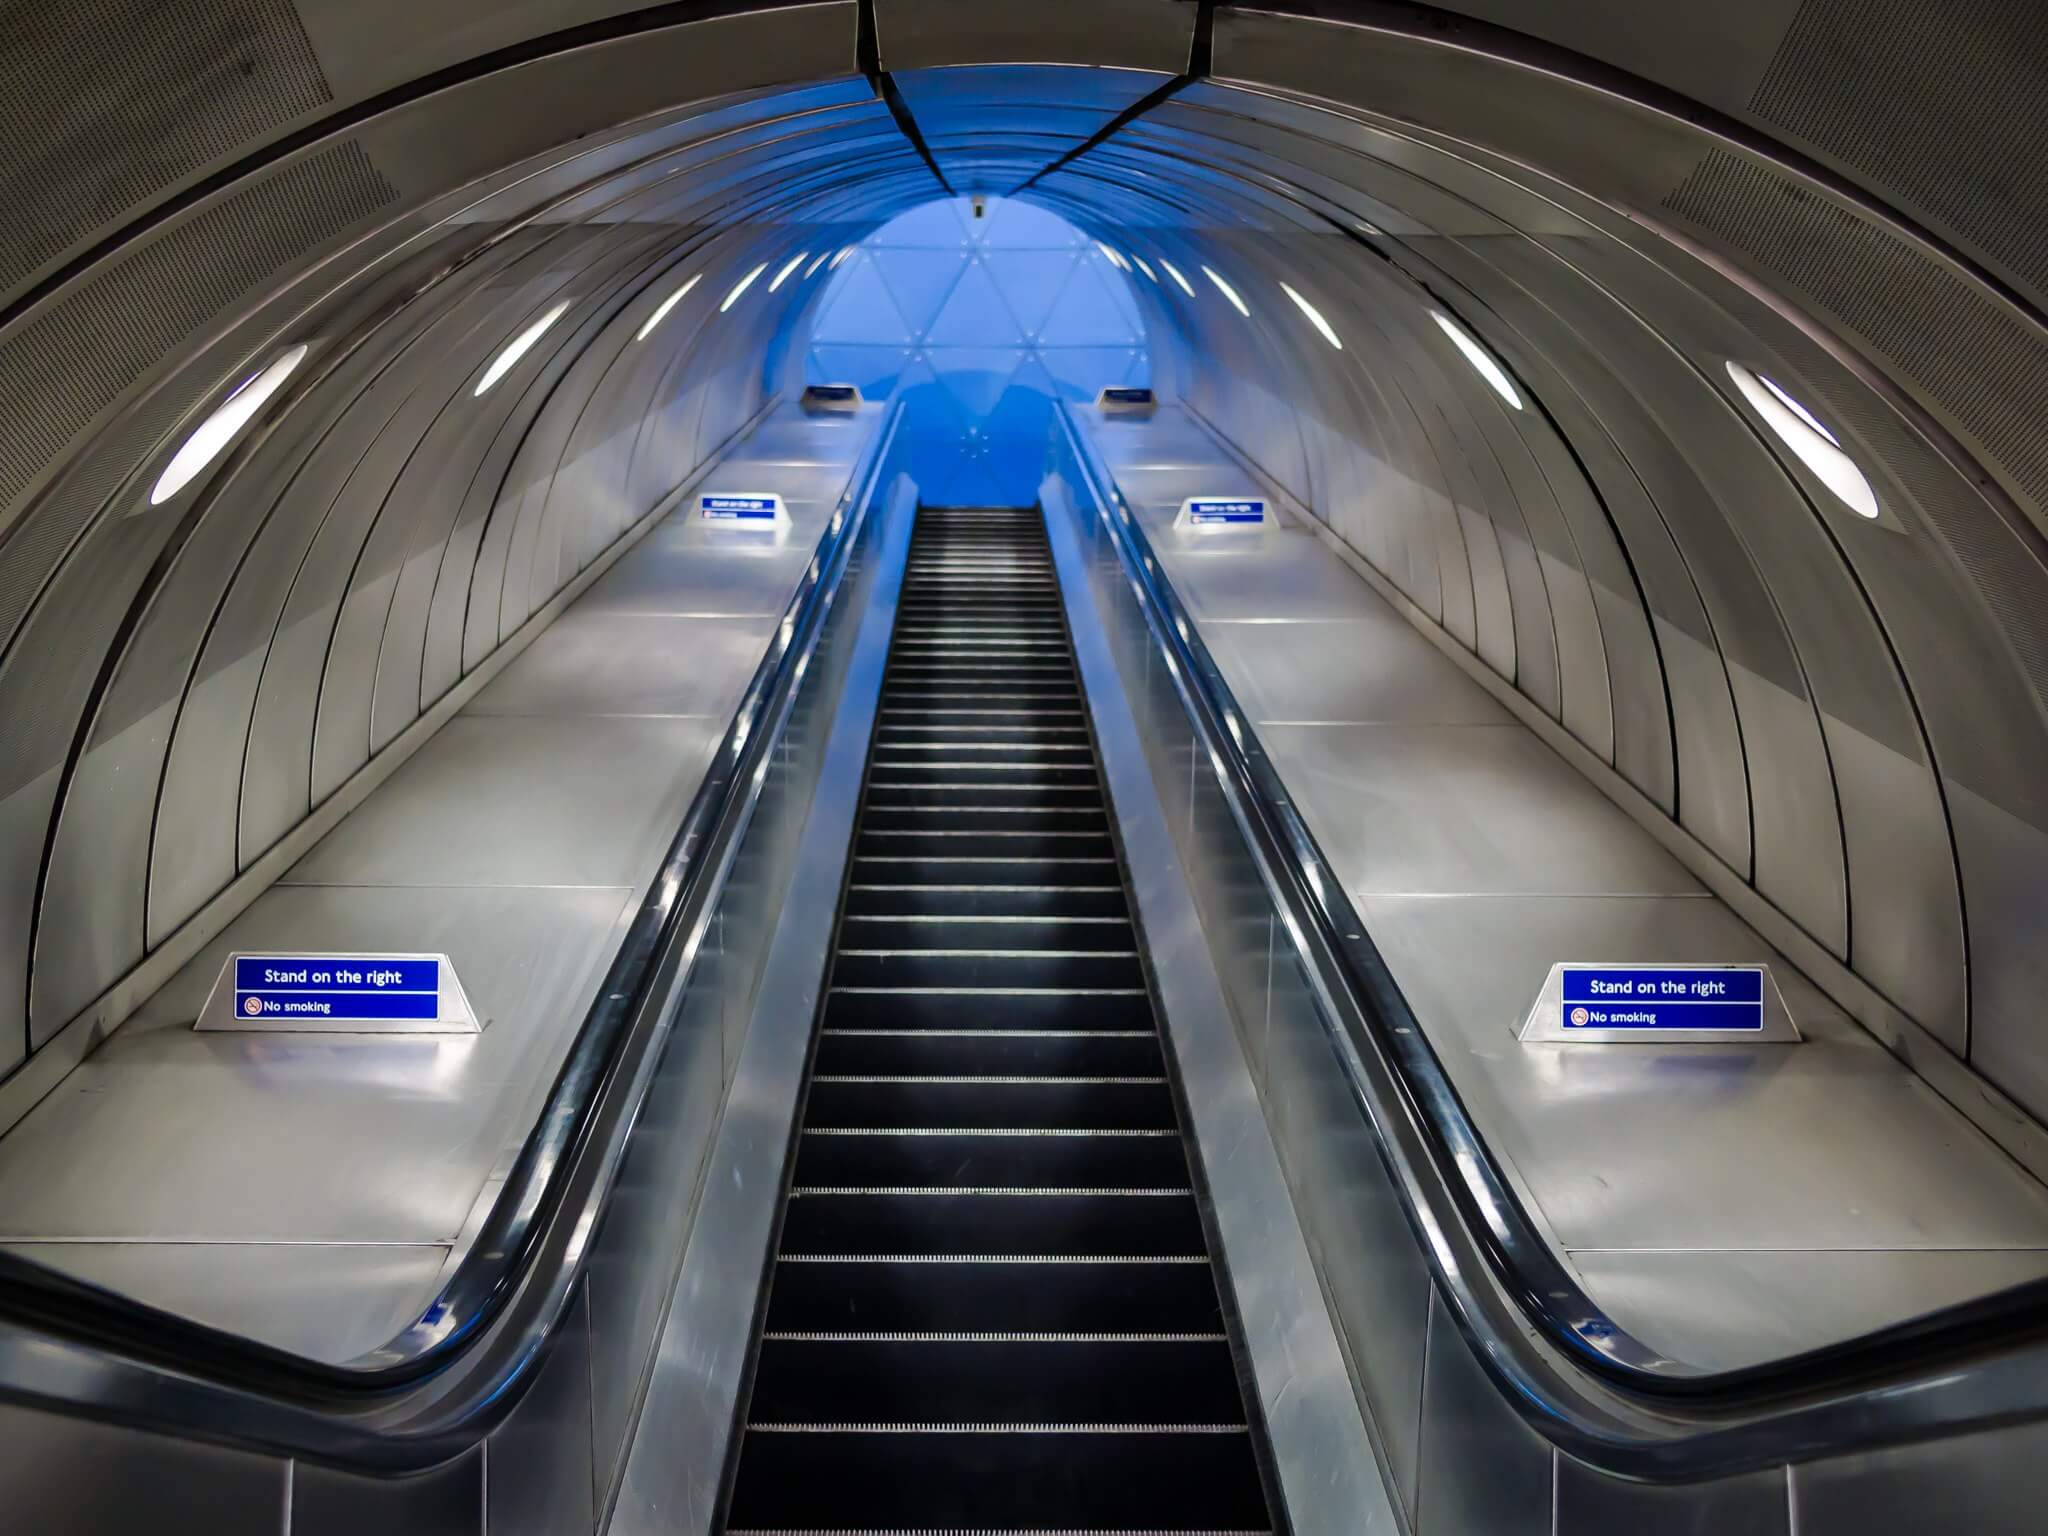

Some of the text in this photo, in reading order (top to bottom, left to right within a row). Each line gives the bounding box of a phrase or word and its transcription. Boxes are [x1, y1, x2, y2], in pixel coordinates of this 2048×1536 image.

[264, 969, 402, 987] Stand on the right
[1590, 980, 1726, 997] Stand on the right
[263, 1001, 330, 1014] No smoking
[1590, 1012, 1656, 1025] No smoking
